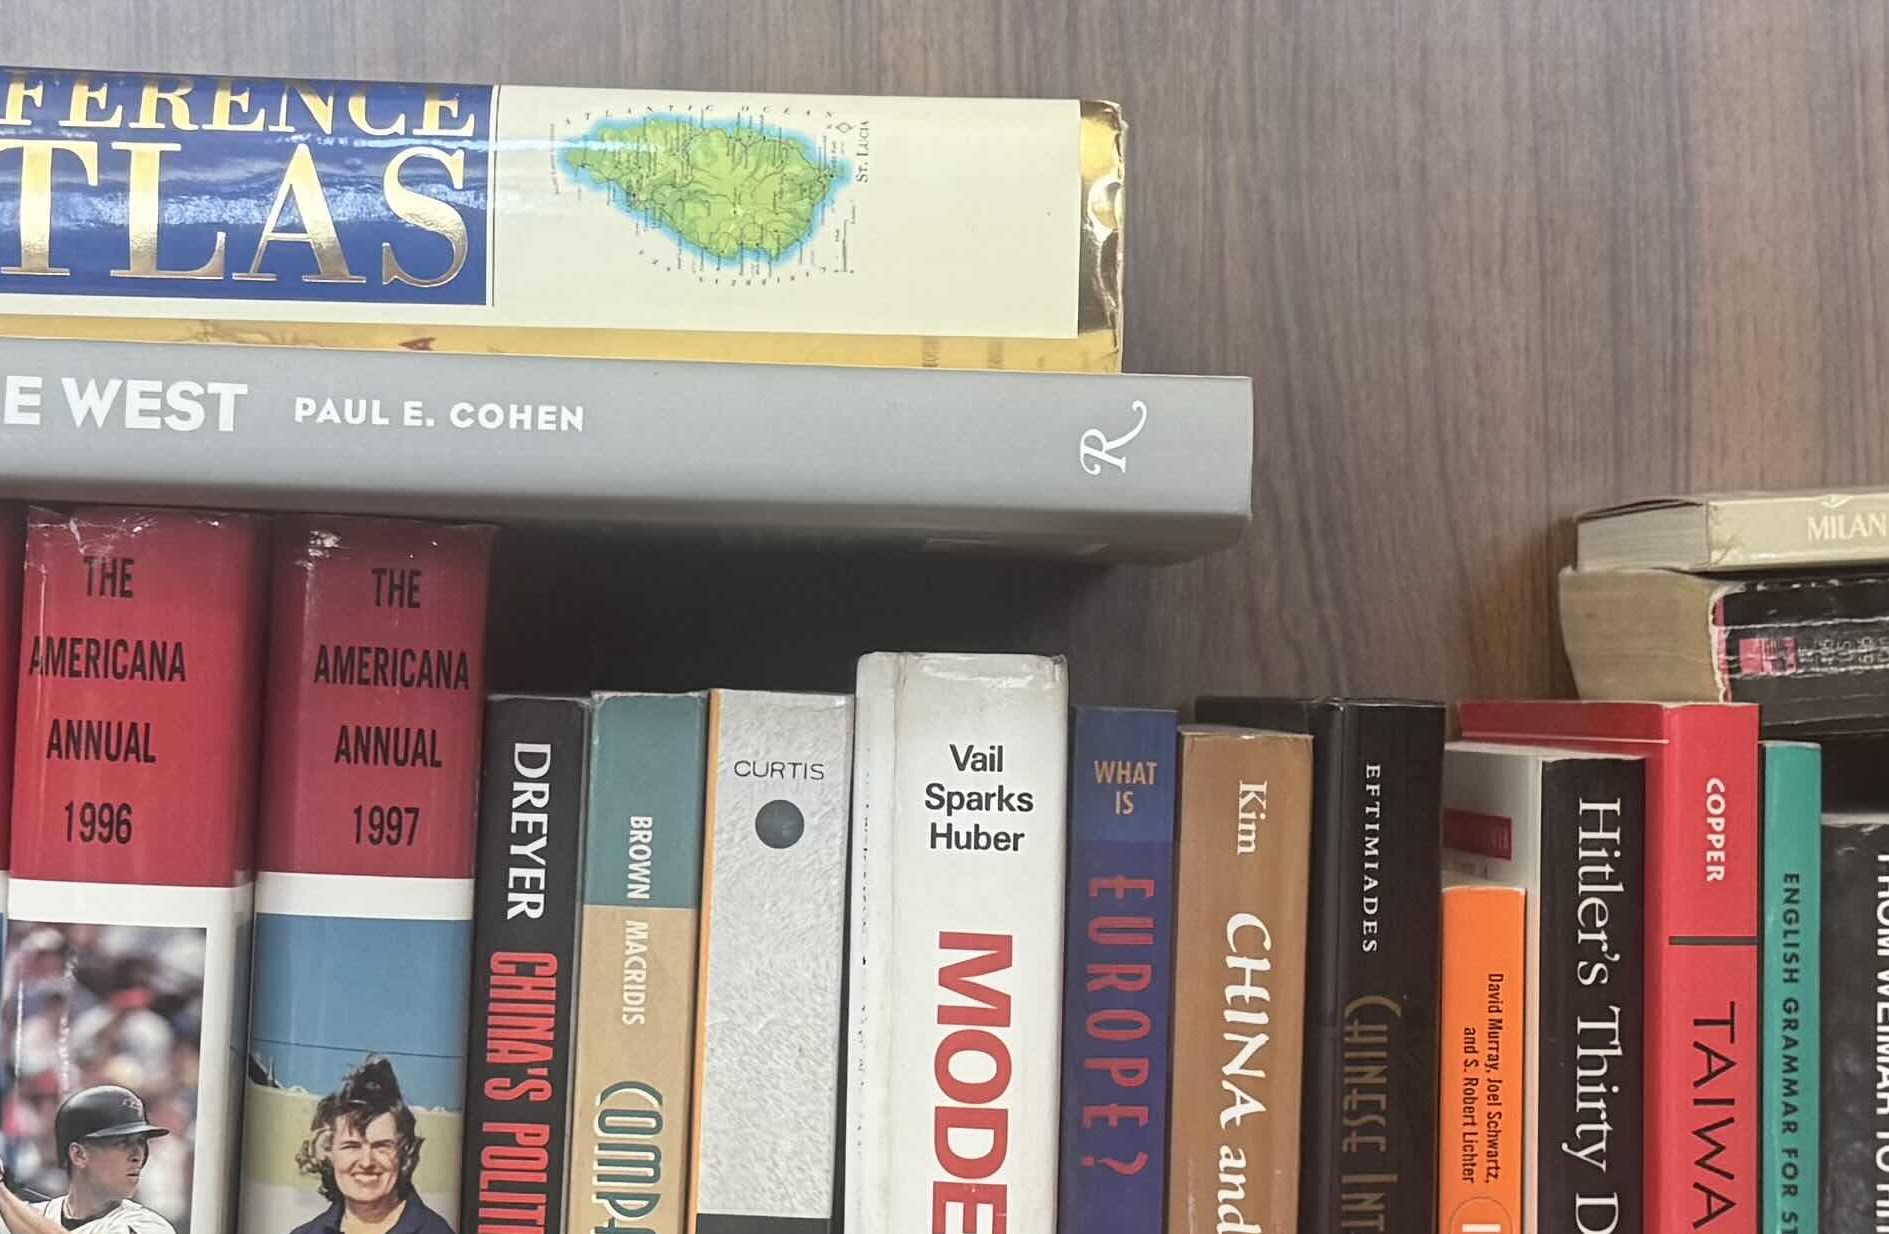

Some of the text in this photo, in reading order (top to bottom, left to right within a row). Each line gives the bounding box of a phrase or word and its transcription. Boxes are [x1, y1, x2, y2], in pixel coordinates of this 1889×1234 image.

[856, 120, 869, 156] LUCIA
[61, 377, 249, 434] WEST
[293, 396, 585, 432] PAUL E. COHEN
[1807, 512, 1887, 541] MILAN
[372, 568, 421, 609] THE
[313, 644, 470, 690] AMERICANA
[334, 725, 442, 768] ANNUAL
[949, 745, 1004, 774] Vail
[734, 759, 825, 781] CURTIS
[1093, 759, 1158, 786] WHAT
[924, 784, 1034, 815] Sparks
[1115, 792, 1134, 815] IS
[1237, 779, 1268, 856] Kim
[353, 805, 420, 847] 1997
[506, 742, 551, 921] DREYER
[929, 823, 1025, 853] Huber
[1705, 777, 1726, 883] COPPER
[1362, 763, 1381, 954] EFTIMIADES
[622, 816, 652, 1026] BROWN MACRIDIS
[1782, 873, 1800, 984] ENGLISH
[1781, 999, 1799, 1134] GRAMMAR
[1781, 1147, 1799, 1197] FOR
